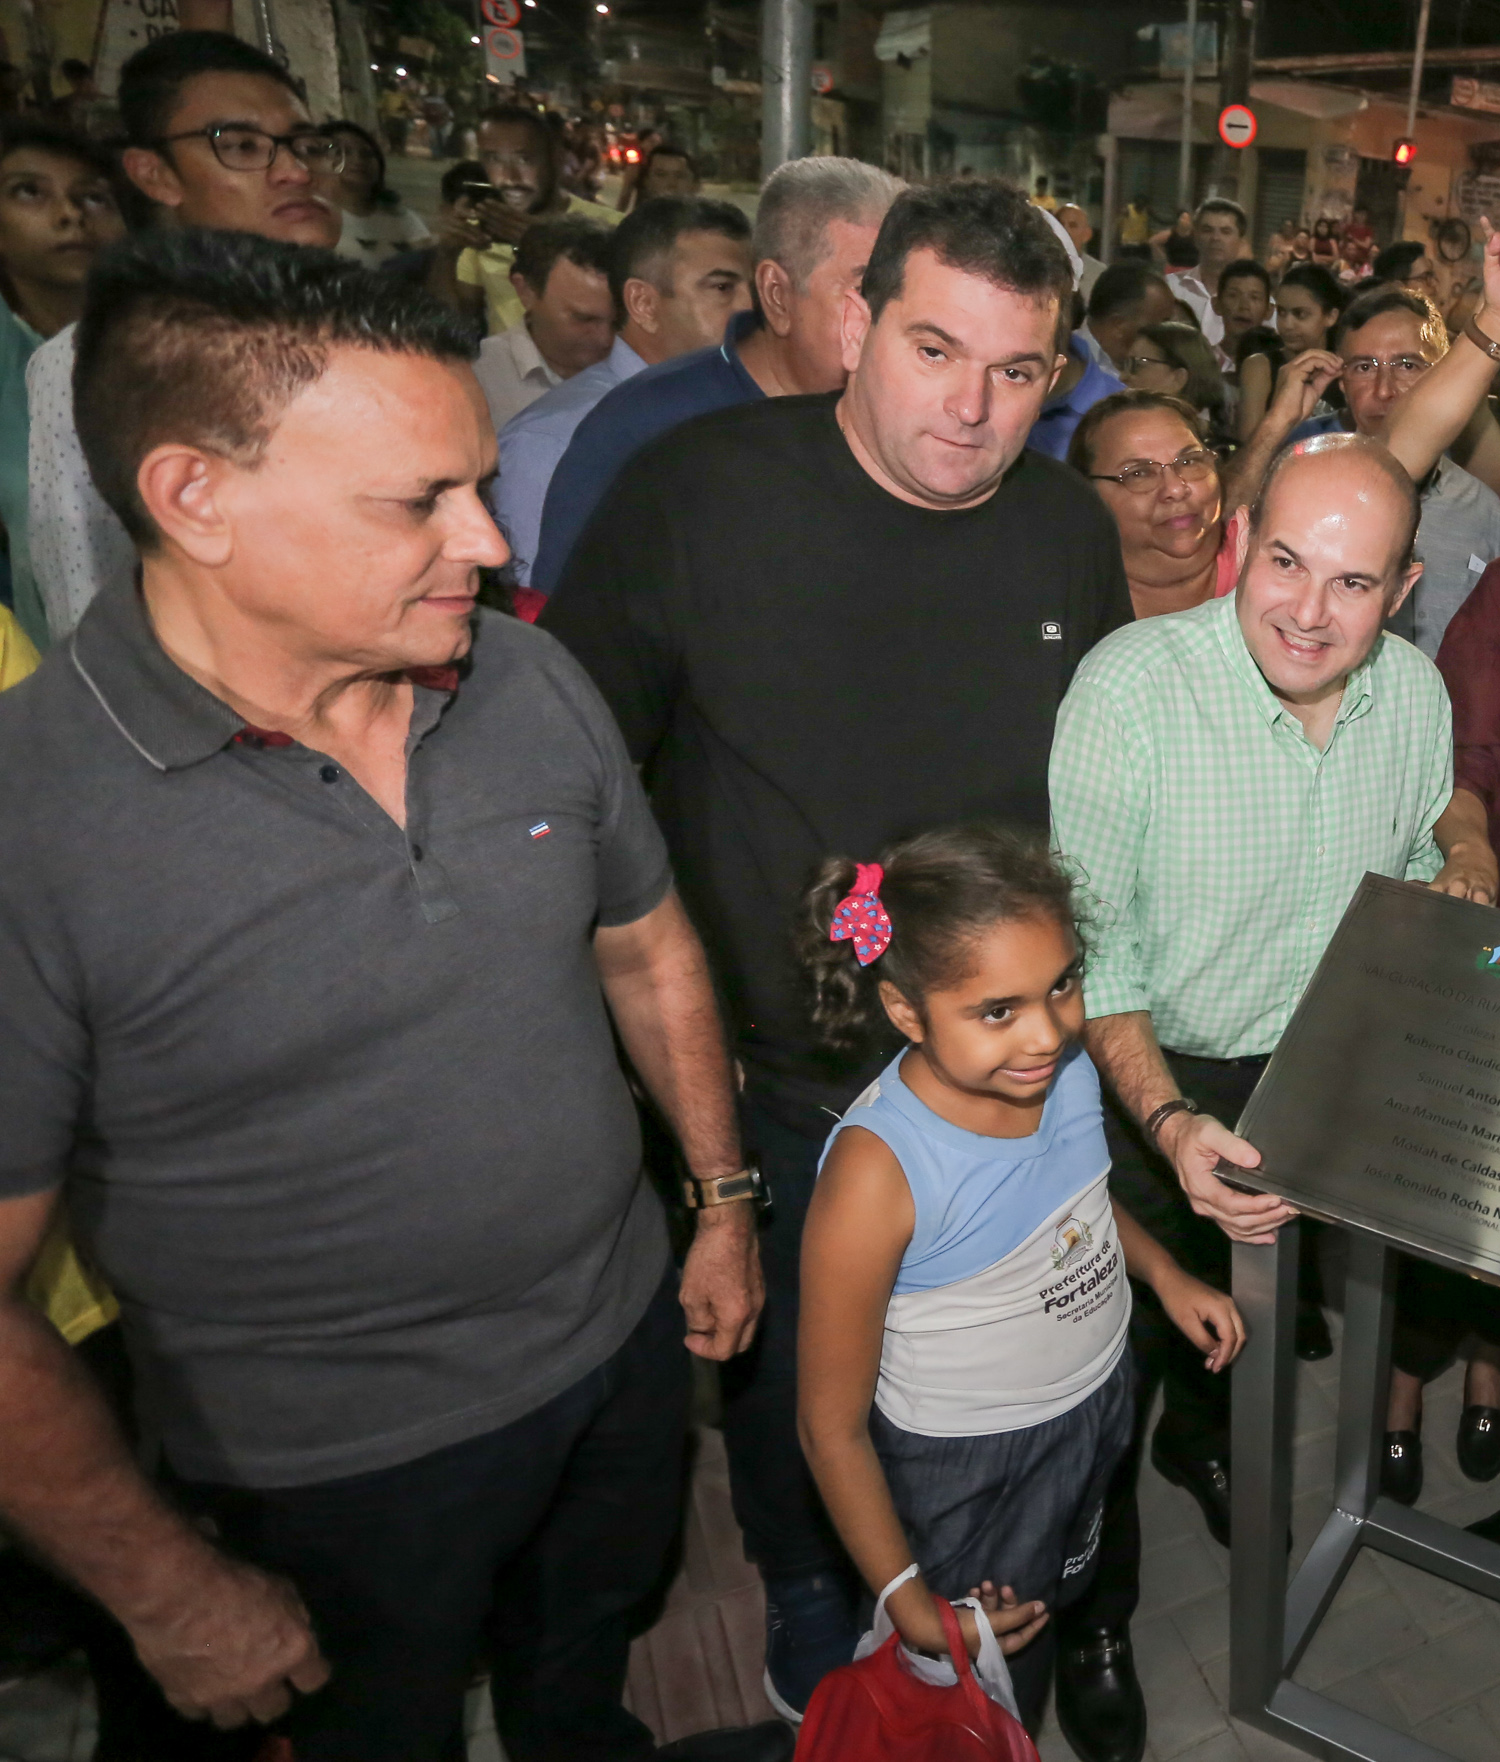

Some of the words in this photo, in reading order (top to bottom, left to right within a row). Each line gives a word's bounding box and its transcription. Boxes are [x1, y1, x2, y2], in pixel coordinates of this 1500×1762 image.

[1356, 960, 1454, 999] INAUGURAÇÃO
[1454, 990, 1475, 1006] DA
[1404, 1031, 1455, 1057] Roberto
[1445, 1017, 1496, 1042] Fortaleza
[1417, 1070, 1464, 1095] Samuel
[1383, 1096, 1411, 1114] Ana
[1412, 1105, 1469, 1133] Manuela
[1391, 1134, 1439, 1160] Mosiah
[1441, 1152, 1458, 1166] de
[1393, 1173, 1448, 1201] Ronaldo
[1450, 1192, 1490, 1216] Rocha
[1039, 1253, 1102, 1300] Prefeitura
[1101, 1240, 1112, 1255] de
[1044, 1252, 1118, 1314] Fortaleza
[1056, 1298, 1095, 1322] Secretaria
[1072, 1314, 1083, 1324] da
[1083, 1291, 1114, 1318] Educação
